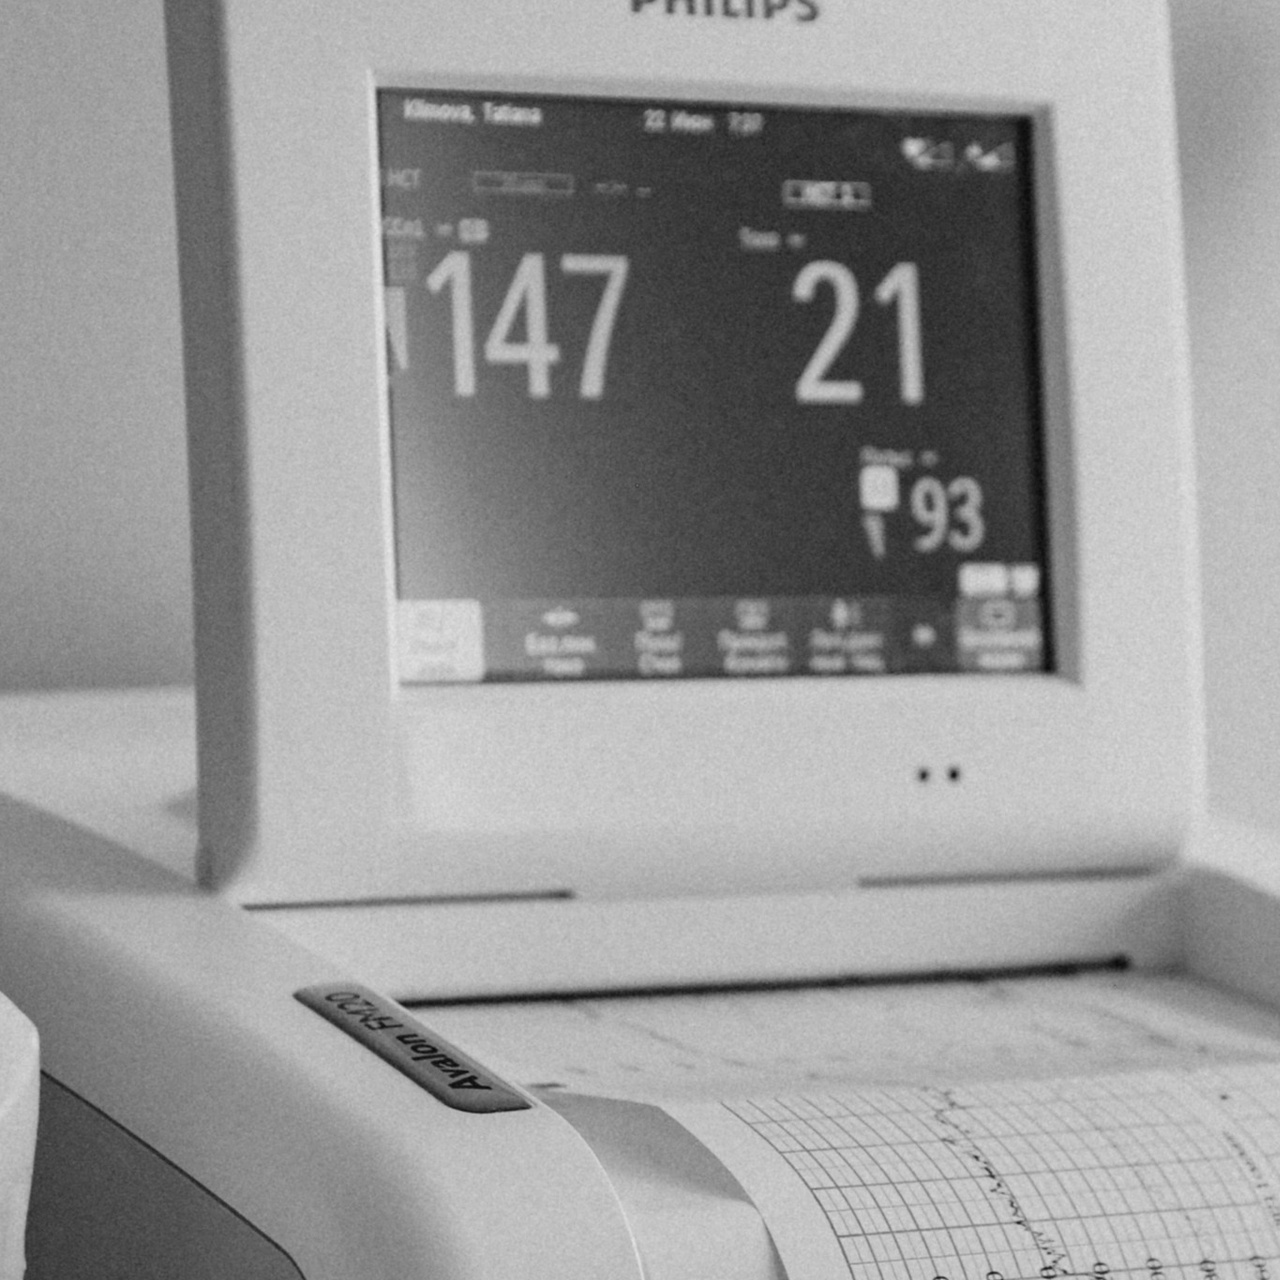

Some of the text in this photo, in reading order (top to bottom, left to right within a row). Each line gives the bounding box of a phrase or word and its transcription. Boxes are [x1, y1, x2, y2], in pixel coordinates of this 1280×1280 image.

[426, 251, 629, 400] 147
[792, 260, 924, 406] 21
[911, 474, 986, 553] 93
[325, 991, 492, 1091] Avalon FM20
